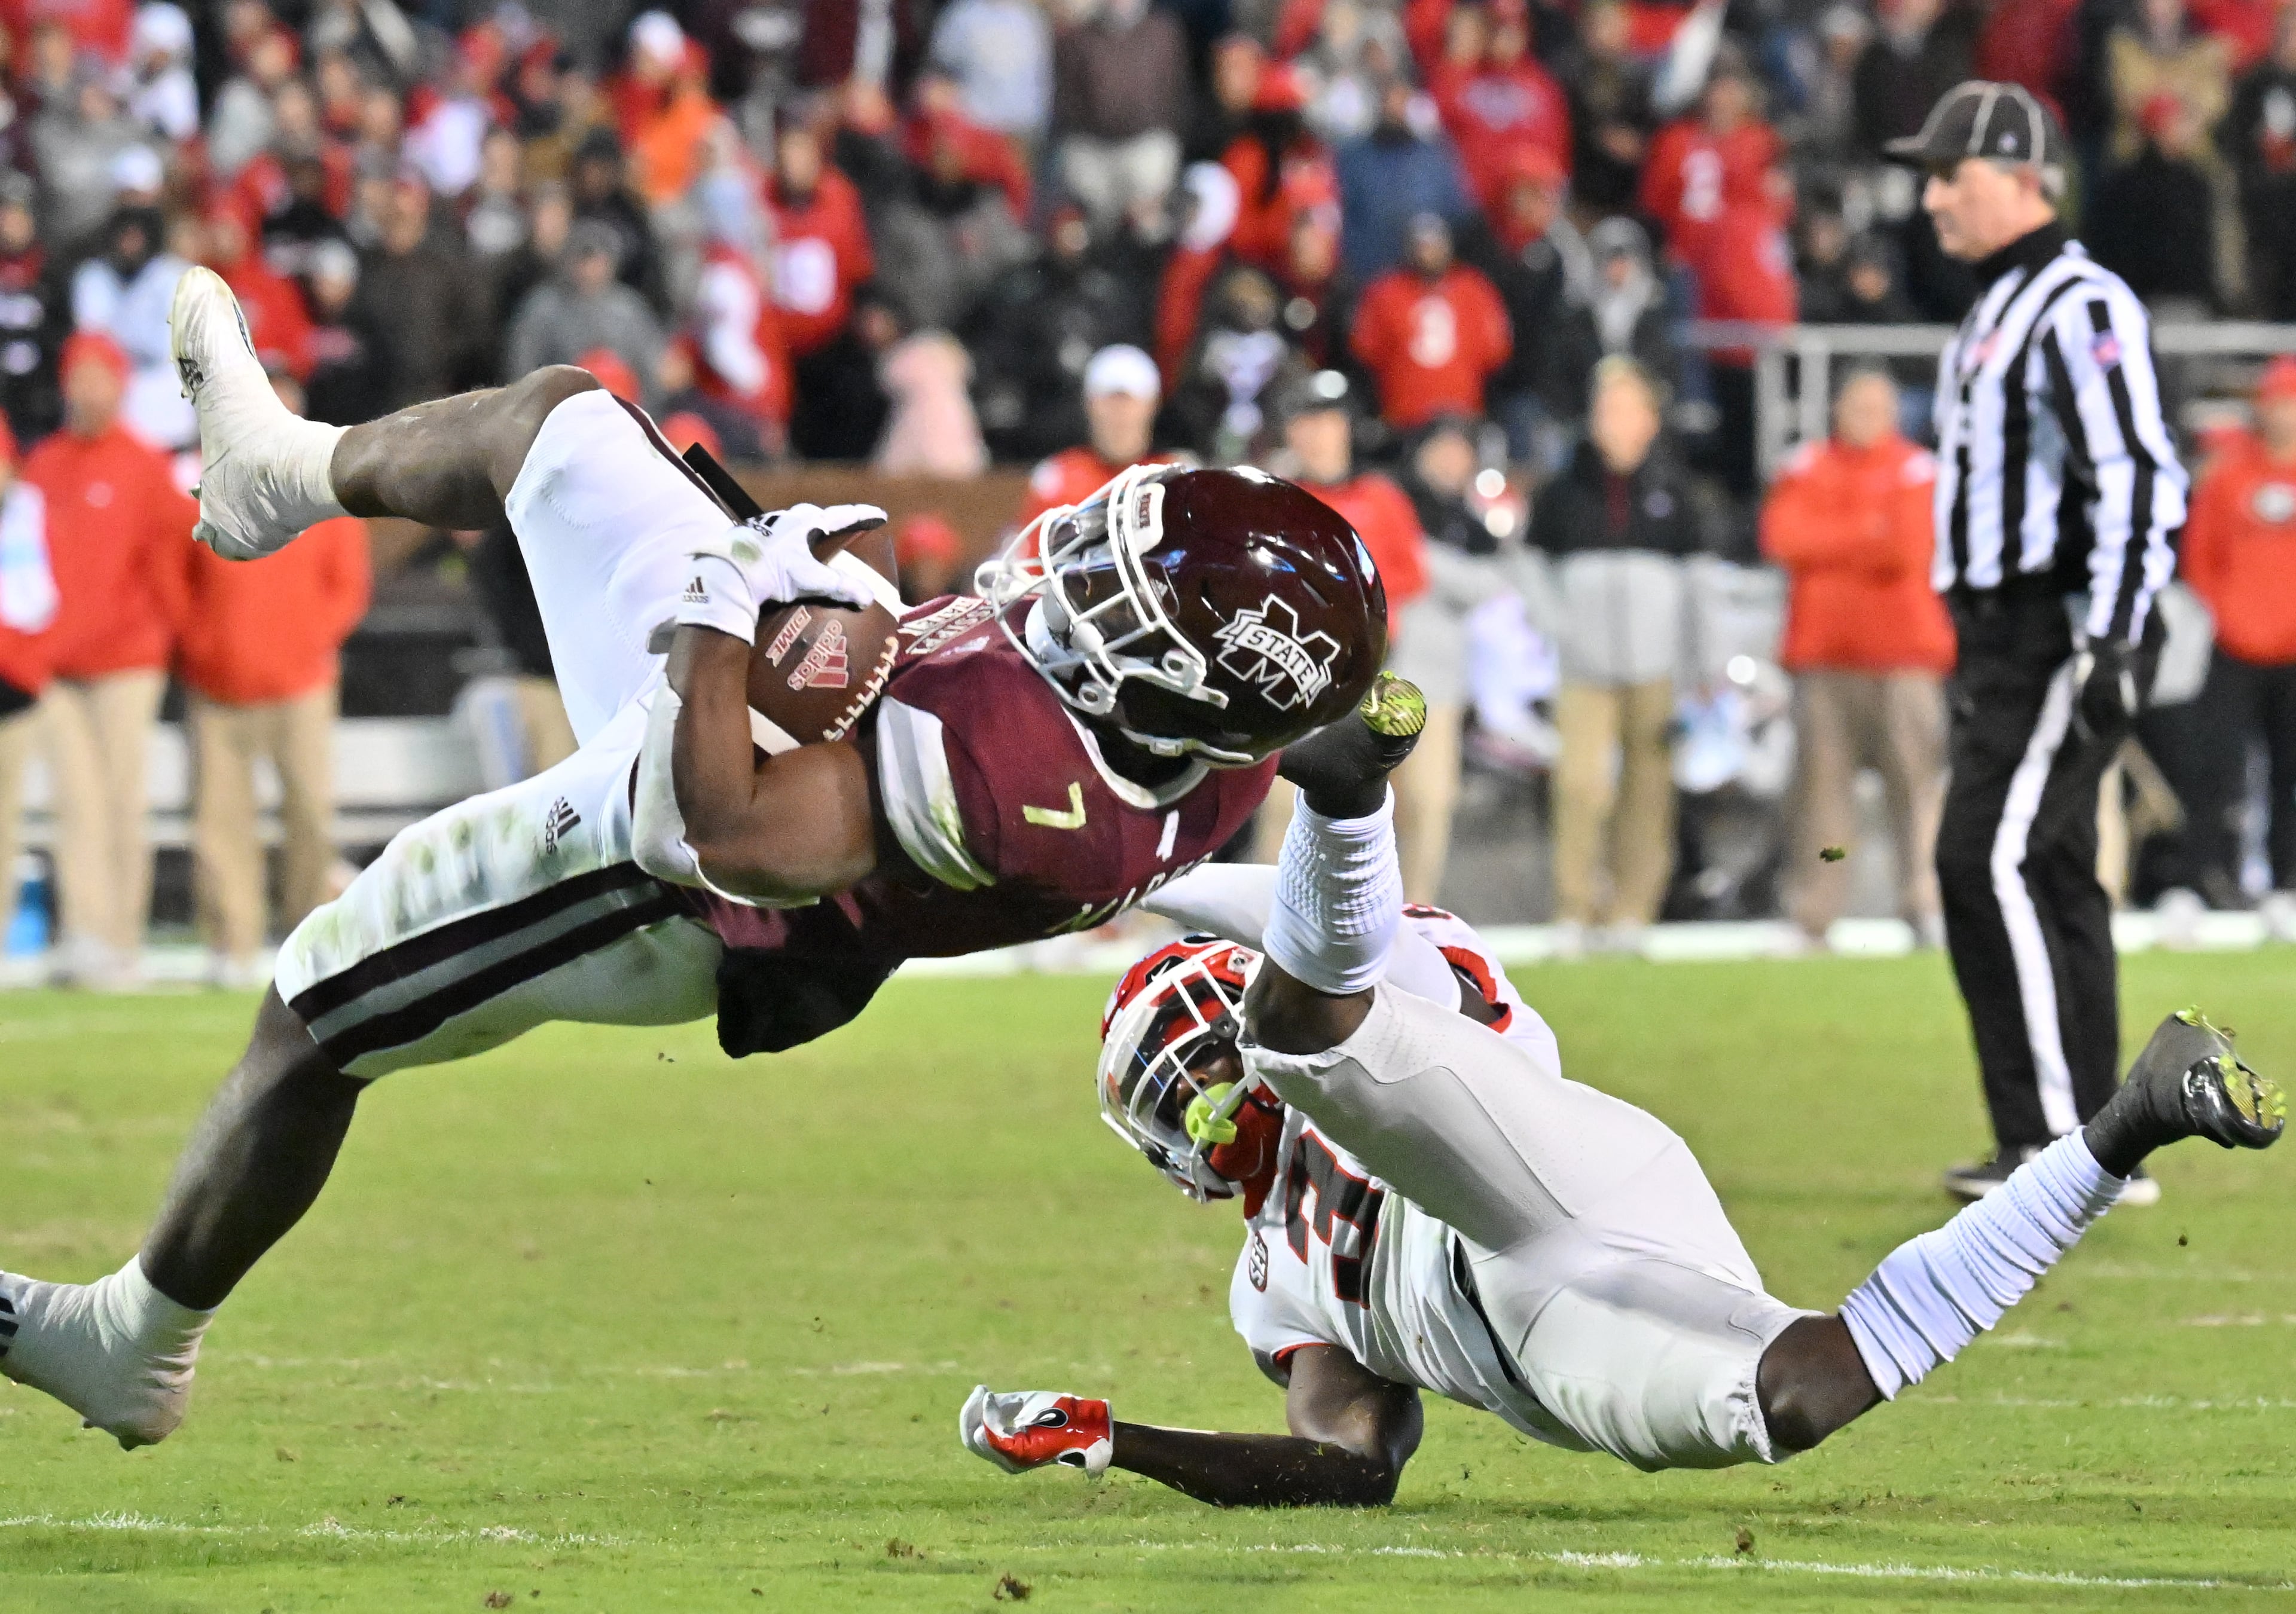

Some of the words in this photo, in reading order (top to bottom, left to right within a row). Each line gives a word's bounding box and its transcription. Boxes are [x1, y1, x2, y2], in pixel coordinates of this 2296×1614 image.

[787, 618, 843, 690] adidas
[1246, 629, 1314, 686] STATE
[1022, 780, 1087, 830] 7
[1286, 1127, 1385, 1310] 3
